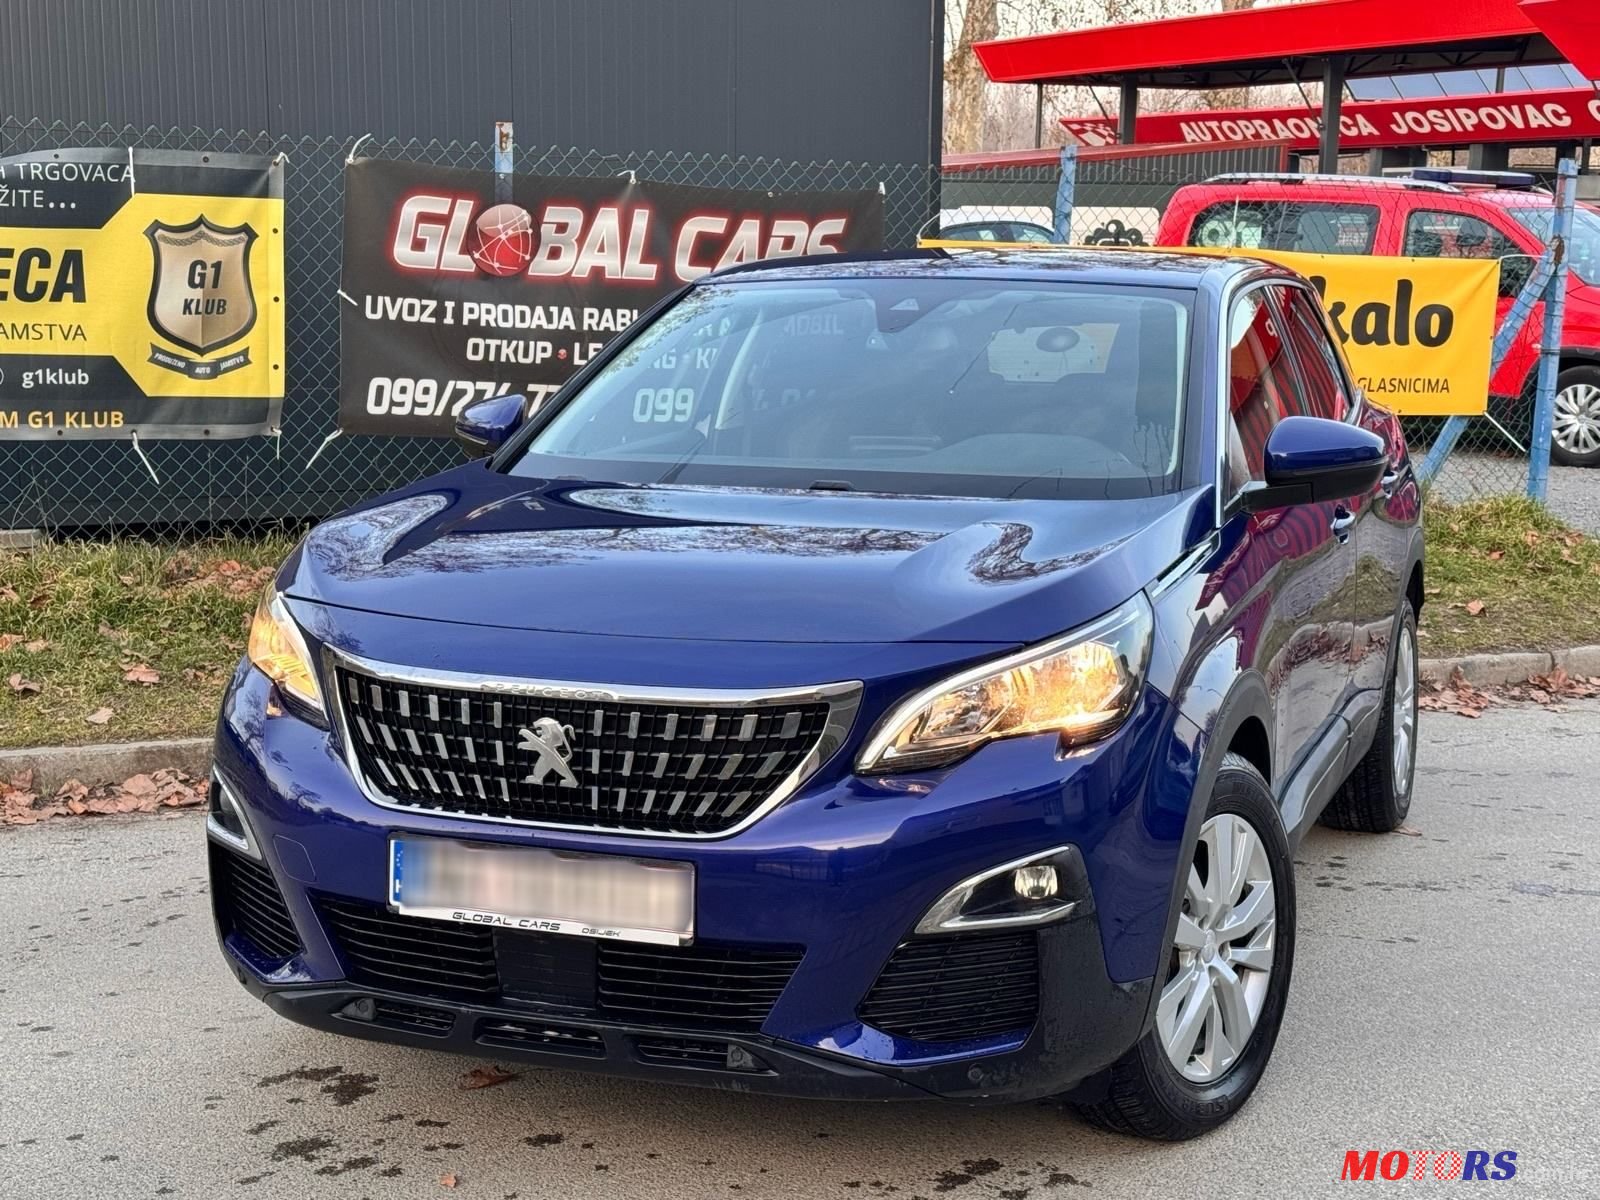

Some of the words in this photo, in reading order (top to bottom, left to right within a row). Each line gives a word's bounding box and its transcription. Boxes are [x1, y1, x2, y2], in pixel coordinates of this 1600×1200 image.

[1179, 113, 1380, 143] AUTOPRAONCA
[1389, 103, 1572, 135] JOSIPOVAC
[14, 163, 136, 182] TRGOVACA
[187, 259, 223, 289] G1
[182, 298, 227, 316] KLUB
[365, 295, 438, 324] UVOZ
[443, 301, 455, 326] I
[462, 302, 576, 331] PRODAJA
[466, 338, 553, 365] OTKUP
[22, 367, 90, 389] g1klub
[27, 410, 55, 429] G1
[64, 410, 125, 429] KLUB
[452, 911, 513, 927] GLOBAL
[518, 919, 562, 932] CARS
[581, 927, 622, 938] OSIJEK
